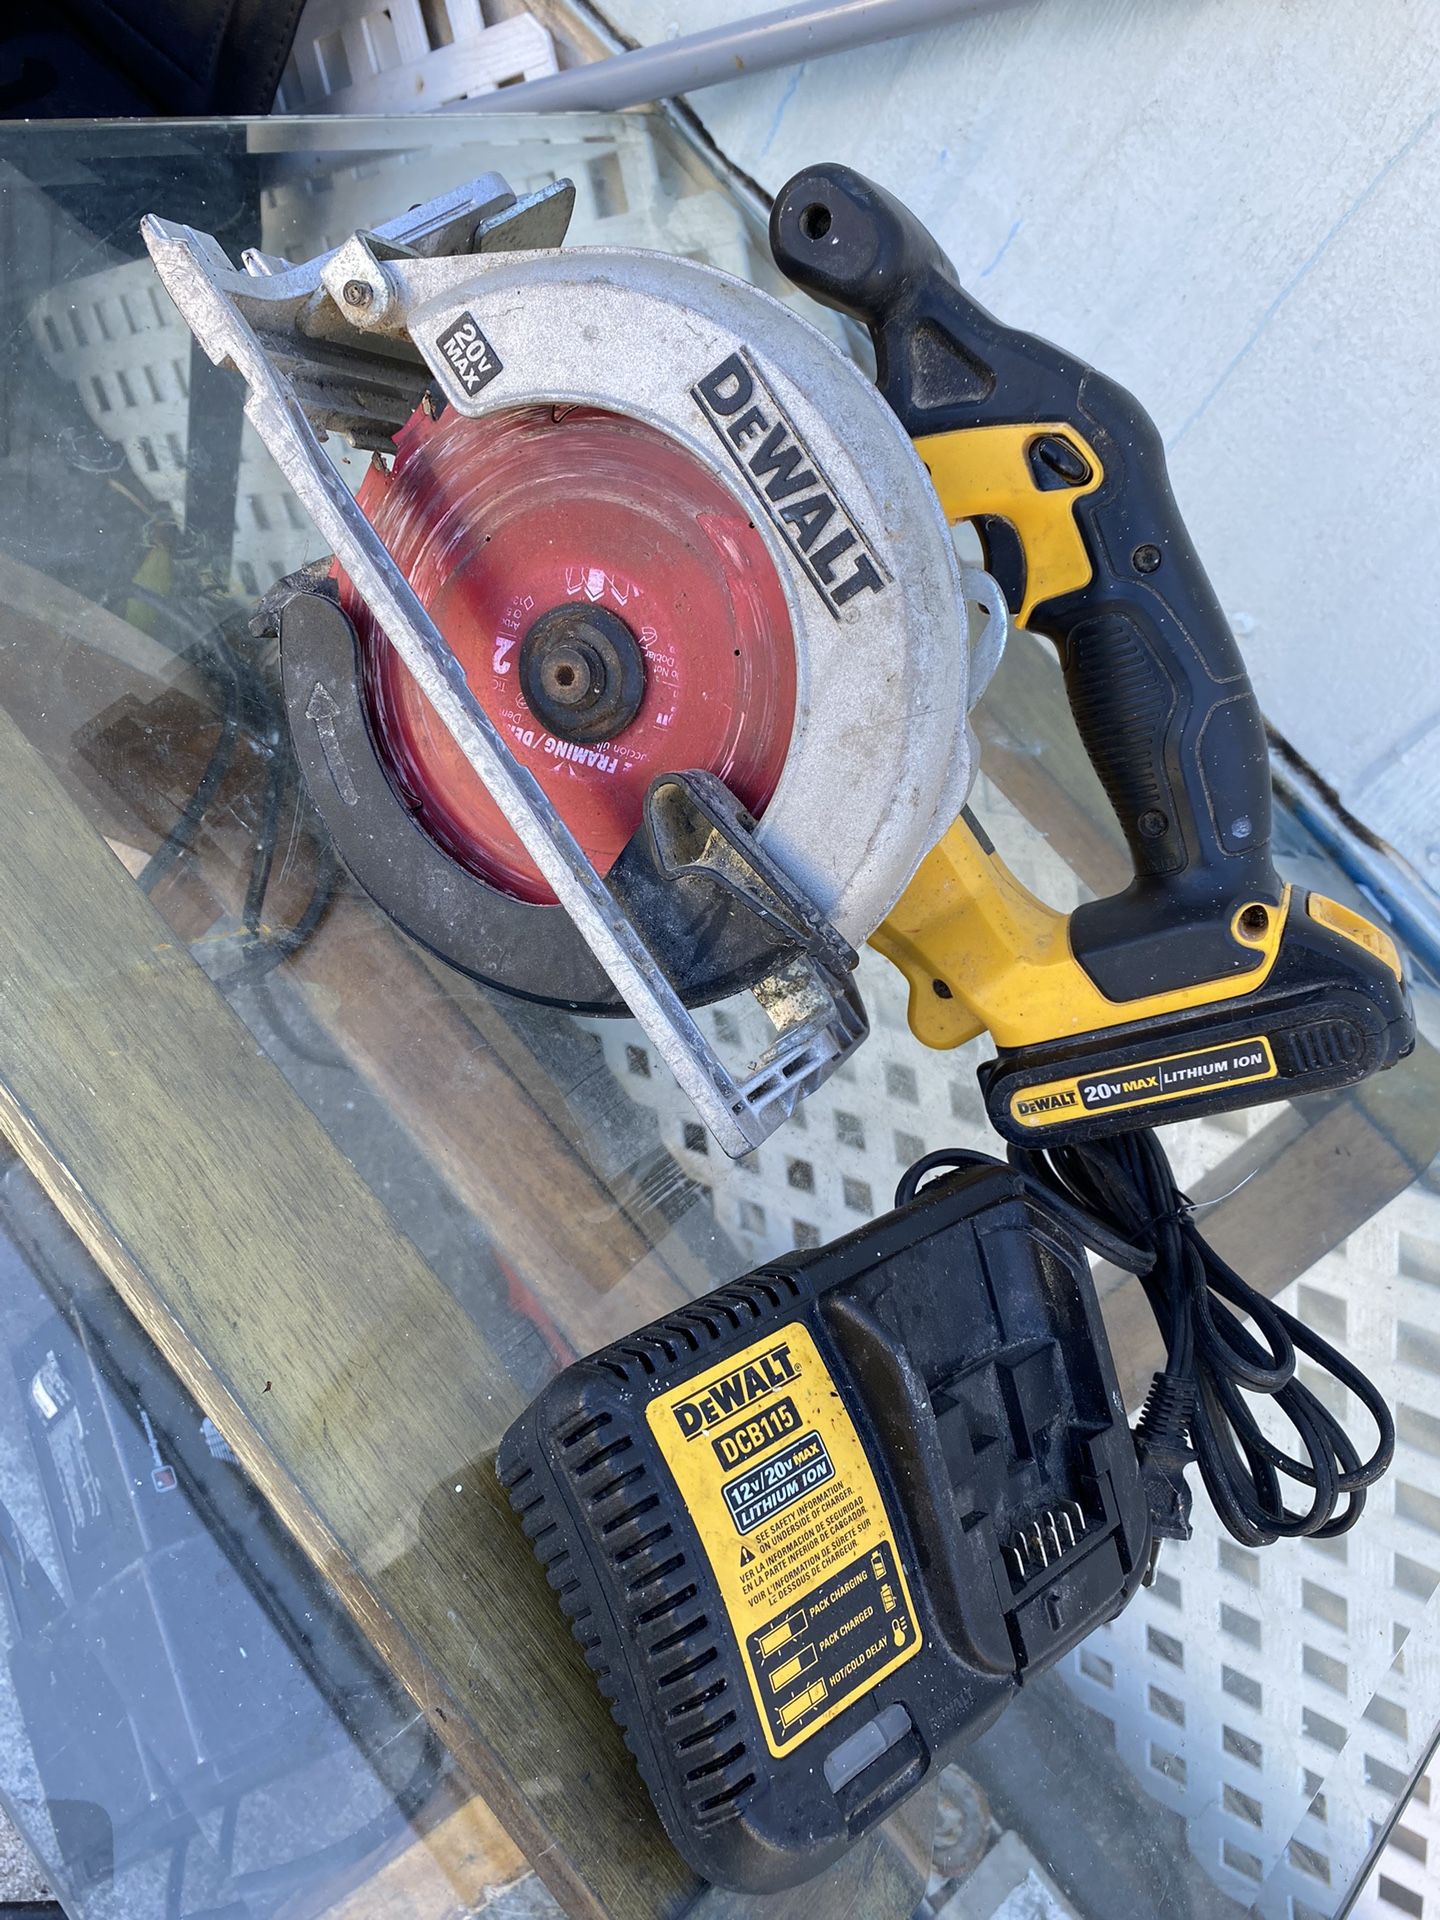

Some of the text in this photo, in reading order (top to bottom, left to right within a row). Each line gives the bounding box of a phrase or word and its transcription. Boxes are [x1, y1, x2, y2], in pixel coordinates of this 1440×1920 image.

[443, 337, 480, 391] MAX
[1122, 1075, 1159, 1093] MAX
[1164, 1060, 1228, 1084] LITHIUM
[1233, 1052, 1263, 1069] ION
[720, 1404, 794, 1463] DCB115
[792, 1442, 820, 1467] MAX
[741, 1461, 828, 1526] LITHIUM ION
[755, 1480, 844, 1544] SEE SAFETY INFORMATION
[759, 1487, 855, 1554] ON UNDERSIDE OF CHARGER.
[739, 1495, 864, 1584] VER LA INFORMACIÓN DE SEGURIDAD
[742, 1583, 754, 1595] EN
[754, 1575, 765, 1587] LA
[764, 1559, 788, 1581] PARTE
[787, 1537, 820, 1565] INFERIOR
[819, 1529, 830, 1541] DE
[748, 1590, 767, 1608] VOIR
[767, 1552, 821, 1596] L'INFORMATION
[820, 1545, 832, 1557] DE
[857, 1518, 872, 1534] SUR
[768, 1594, 778, 1606] LE
[777, 1572, 811, 1600] DESSOUS
[811, 1563, 823, 1576] DE
[809, 1569, 868, 1618] PACK CHARGING
[819, 1605, 874, 1652] PACK CHARGED
[829, 1635, 888, 1687] HOT/COLD DELAY
